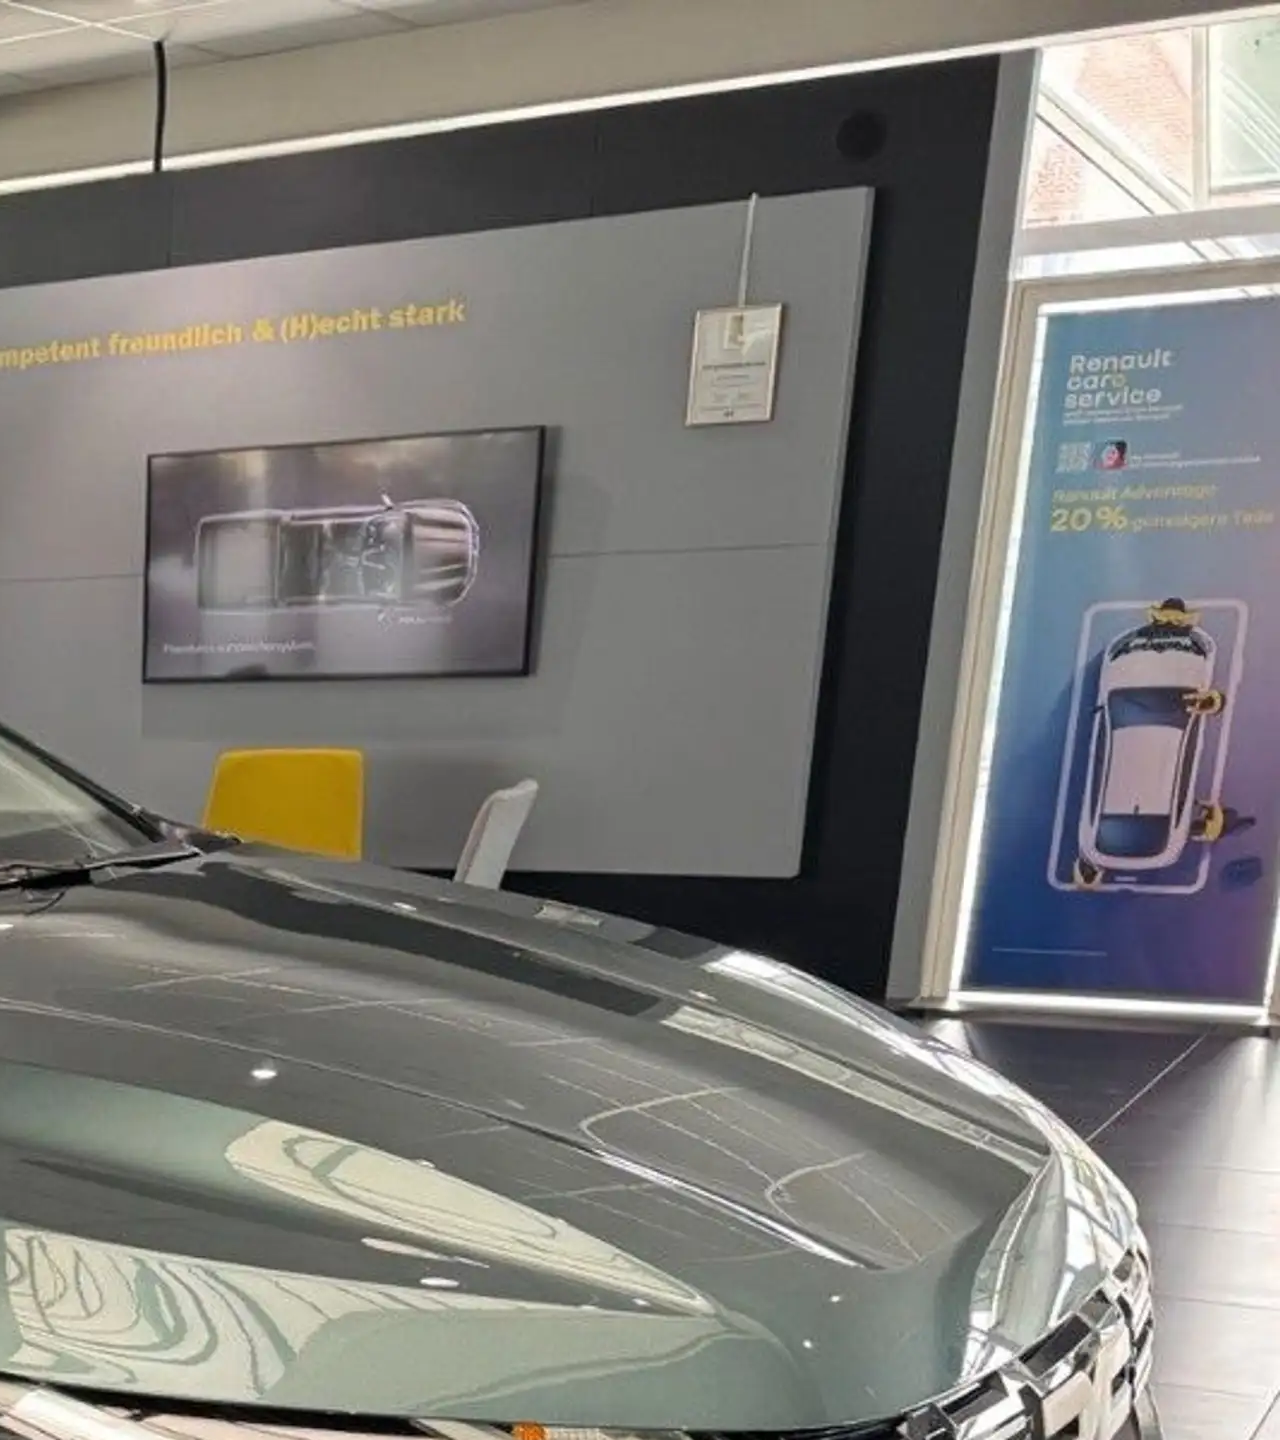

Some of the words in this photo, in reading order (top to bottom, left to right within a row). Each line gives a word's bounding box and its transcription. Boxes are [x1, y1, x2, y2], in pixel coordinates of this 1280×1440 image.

[108, 323, 242, 356] freundlich
[252, 317, 274, 342] &
[280, 306, 383, 344] (H)echt
[389, 298, 467, 329] stark
[1070, 348, 1175, 374] Renault
[1066, 374, 1126, 391] care
[1064, 386, 1162, 409] service
